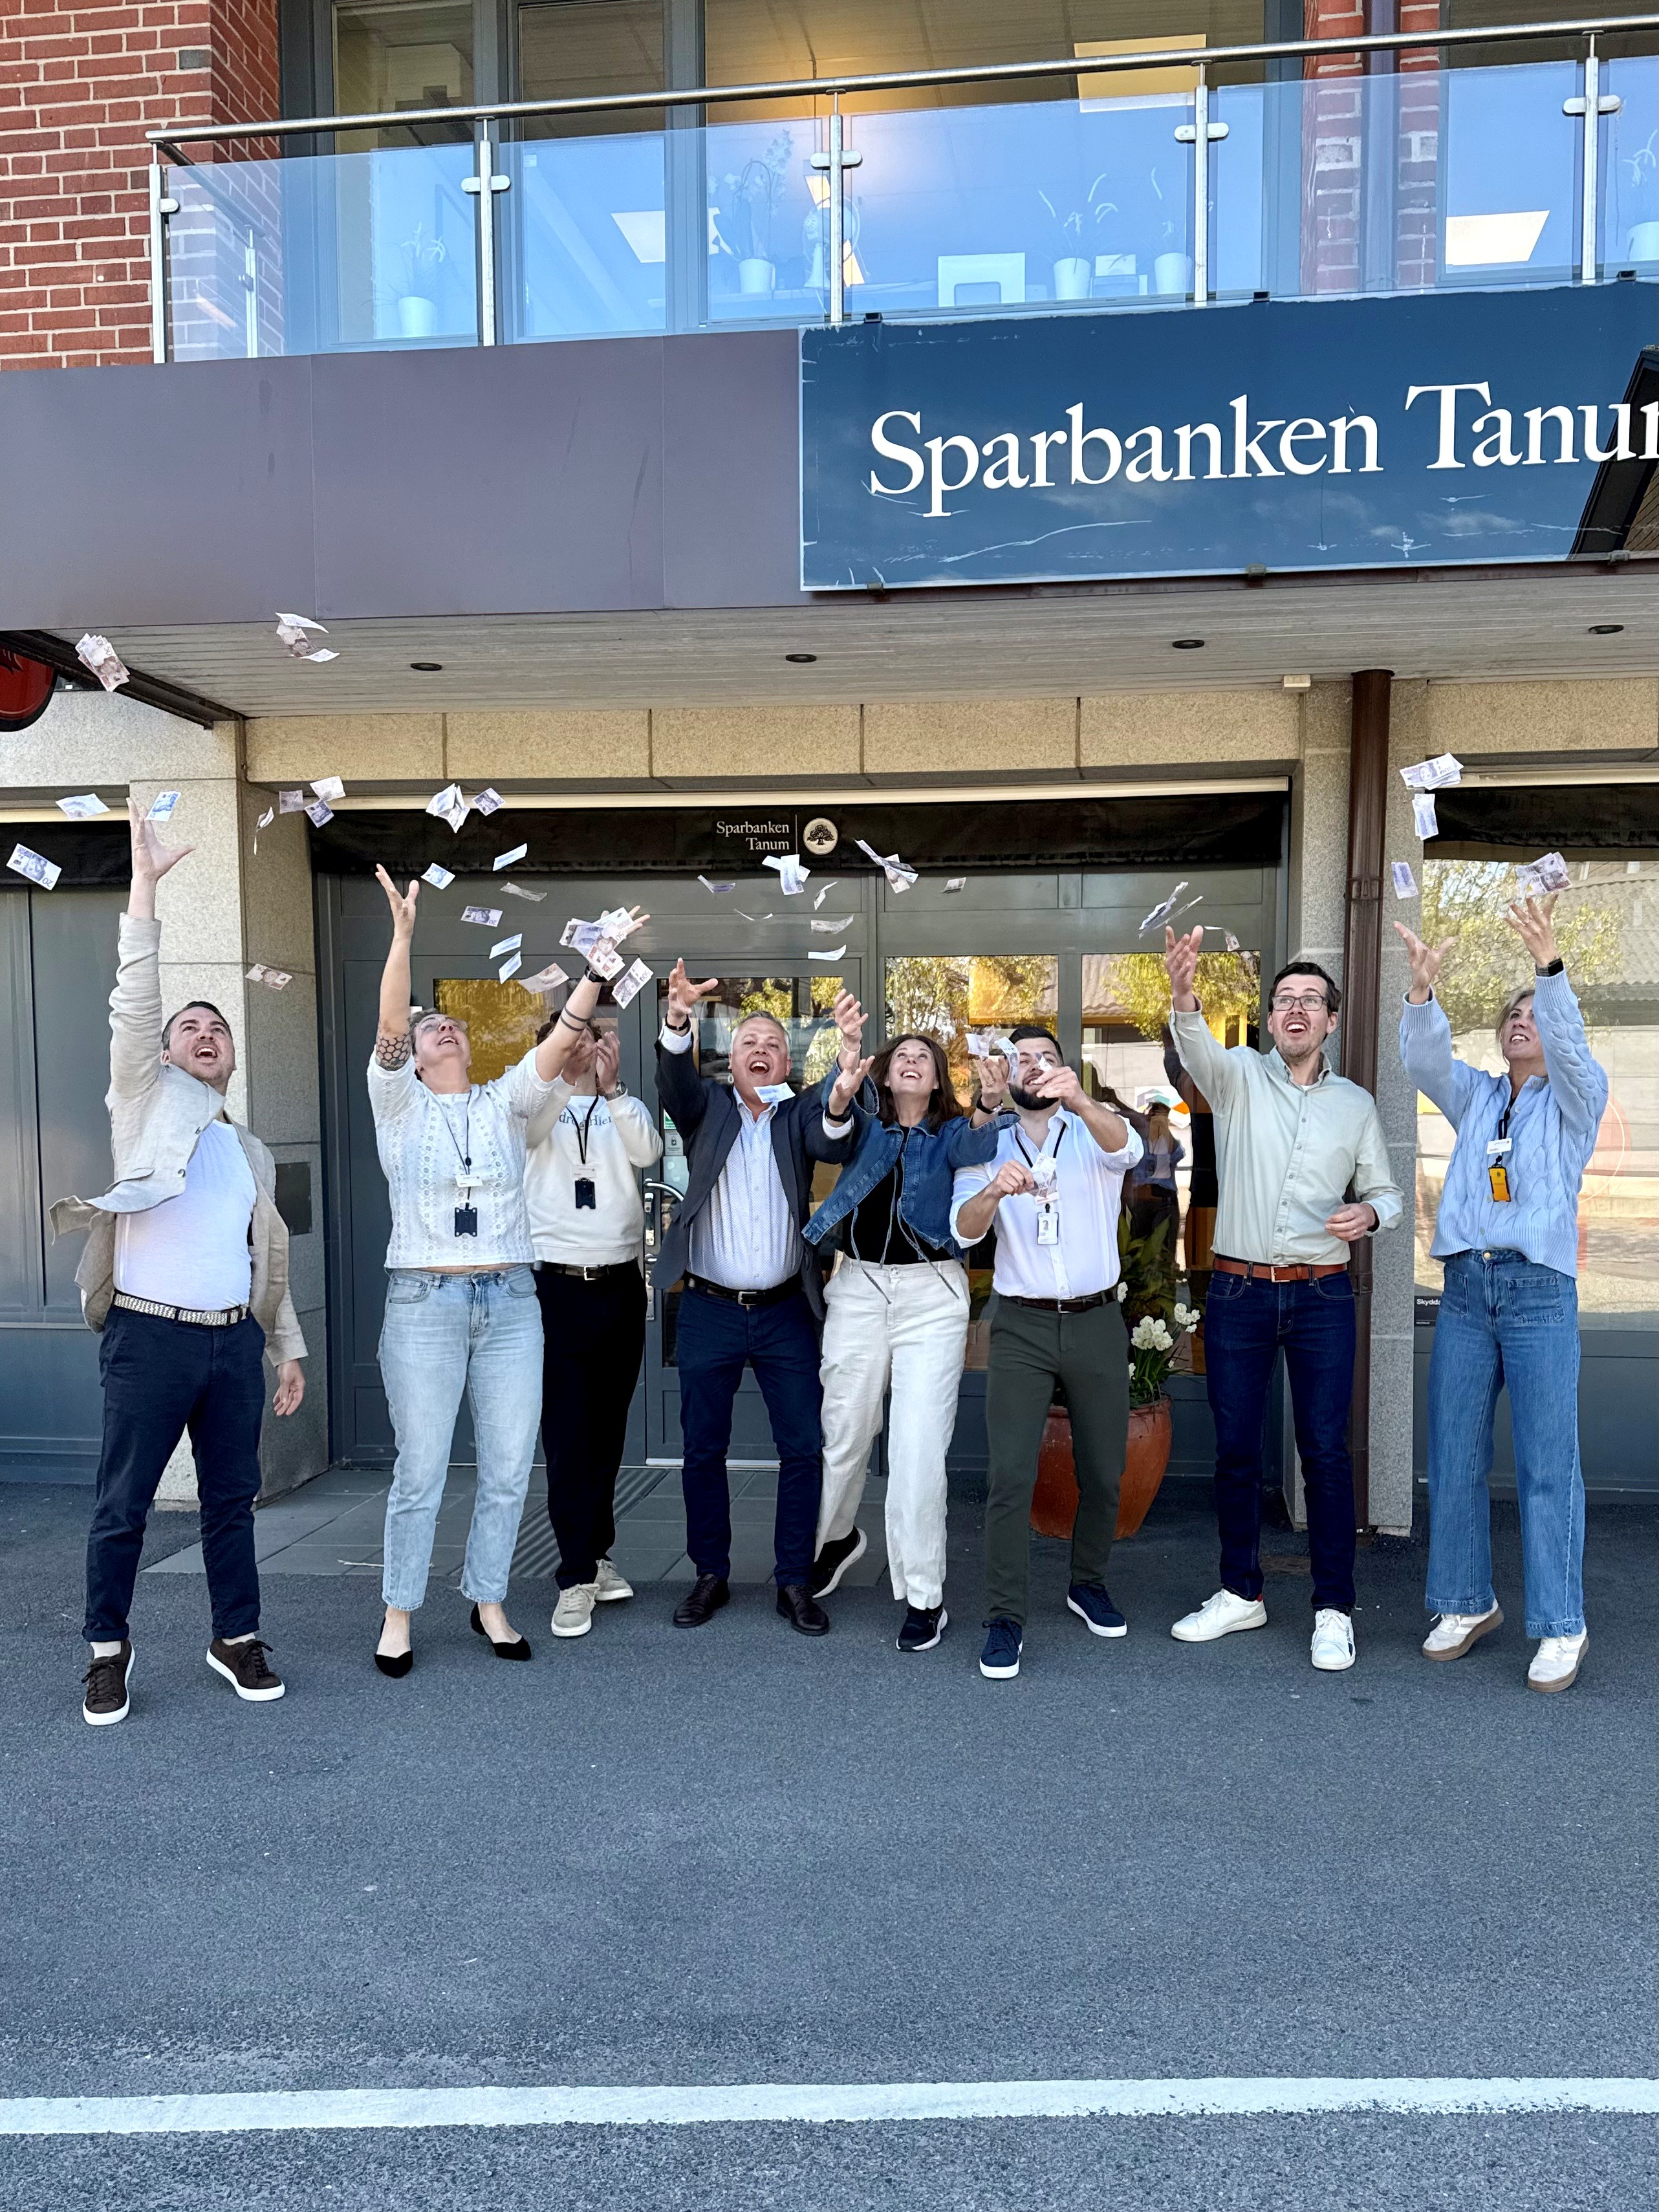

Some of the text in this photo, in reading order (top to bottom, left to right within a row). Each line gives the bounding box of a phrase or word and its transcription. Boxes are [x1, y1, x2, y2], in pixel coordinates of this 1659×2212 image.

[870, 380, 1659, 518] Sparbanken Tanu
[716, 820, 790, 838] Sparbanken
[745, 837, 790, 851] Tanum
[42, 877, 54, 888] 20
[615, 931, 625, 941] 50
